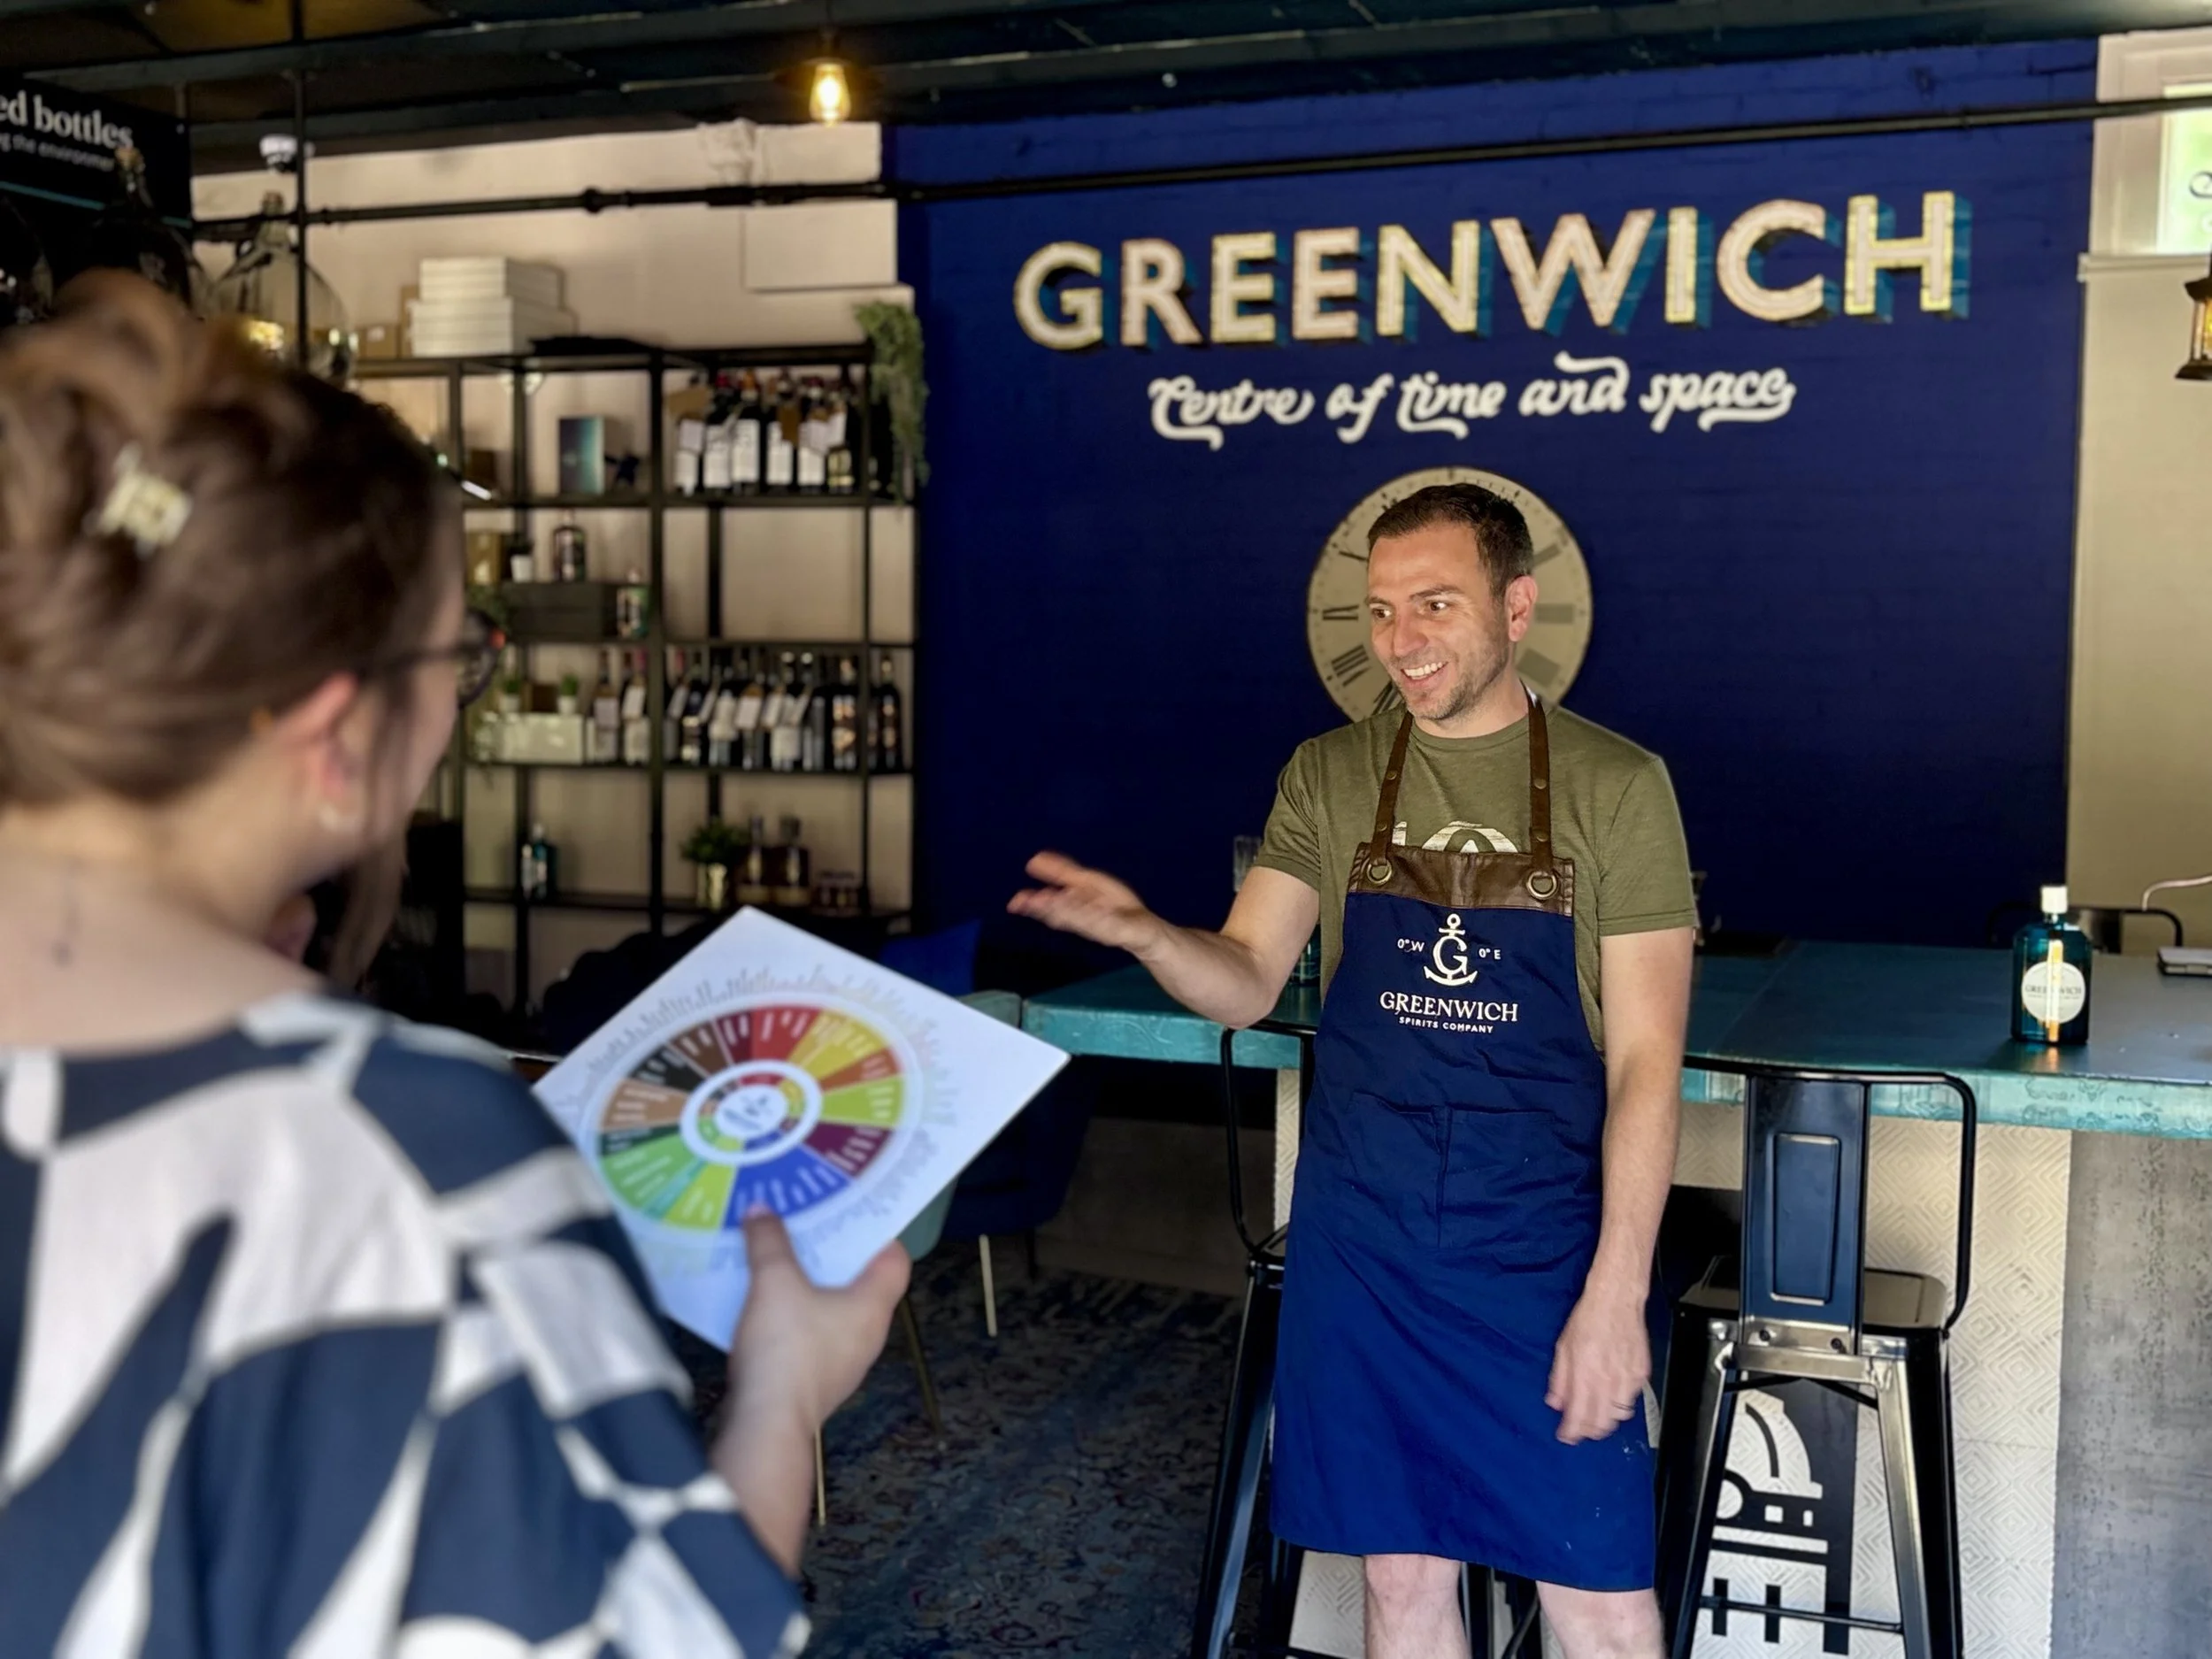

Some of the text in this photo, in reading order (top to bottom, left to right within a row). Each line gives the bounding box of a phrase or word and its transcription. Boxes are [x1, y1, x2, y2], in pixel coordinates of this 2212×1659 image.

[33, 94, 134, 150] bottles
[1013, 190, 1959, 349] GREENWICH
[1148, 350, 1797, 451] Centre of time and space
[1379, 991, 1518, 1022] GREENWICH
[1399, 1016, 1494, 1033] SPIRITS COMPANY
